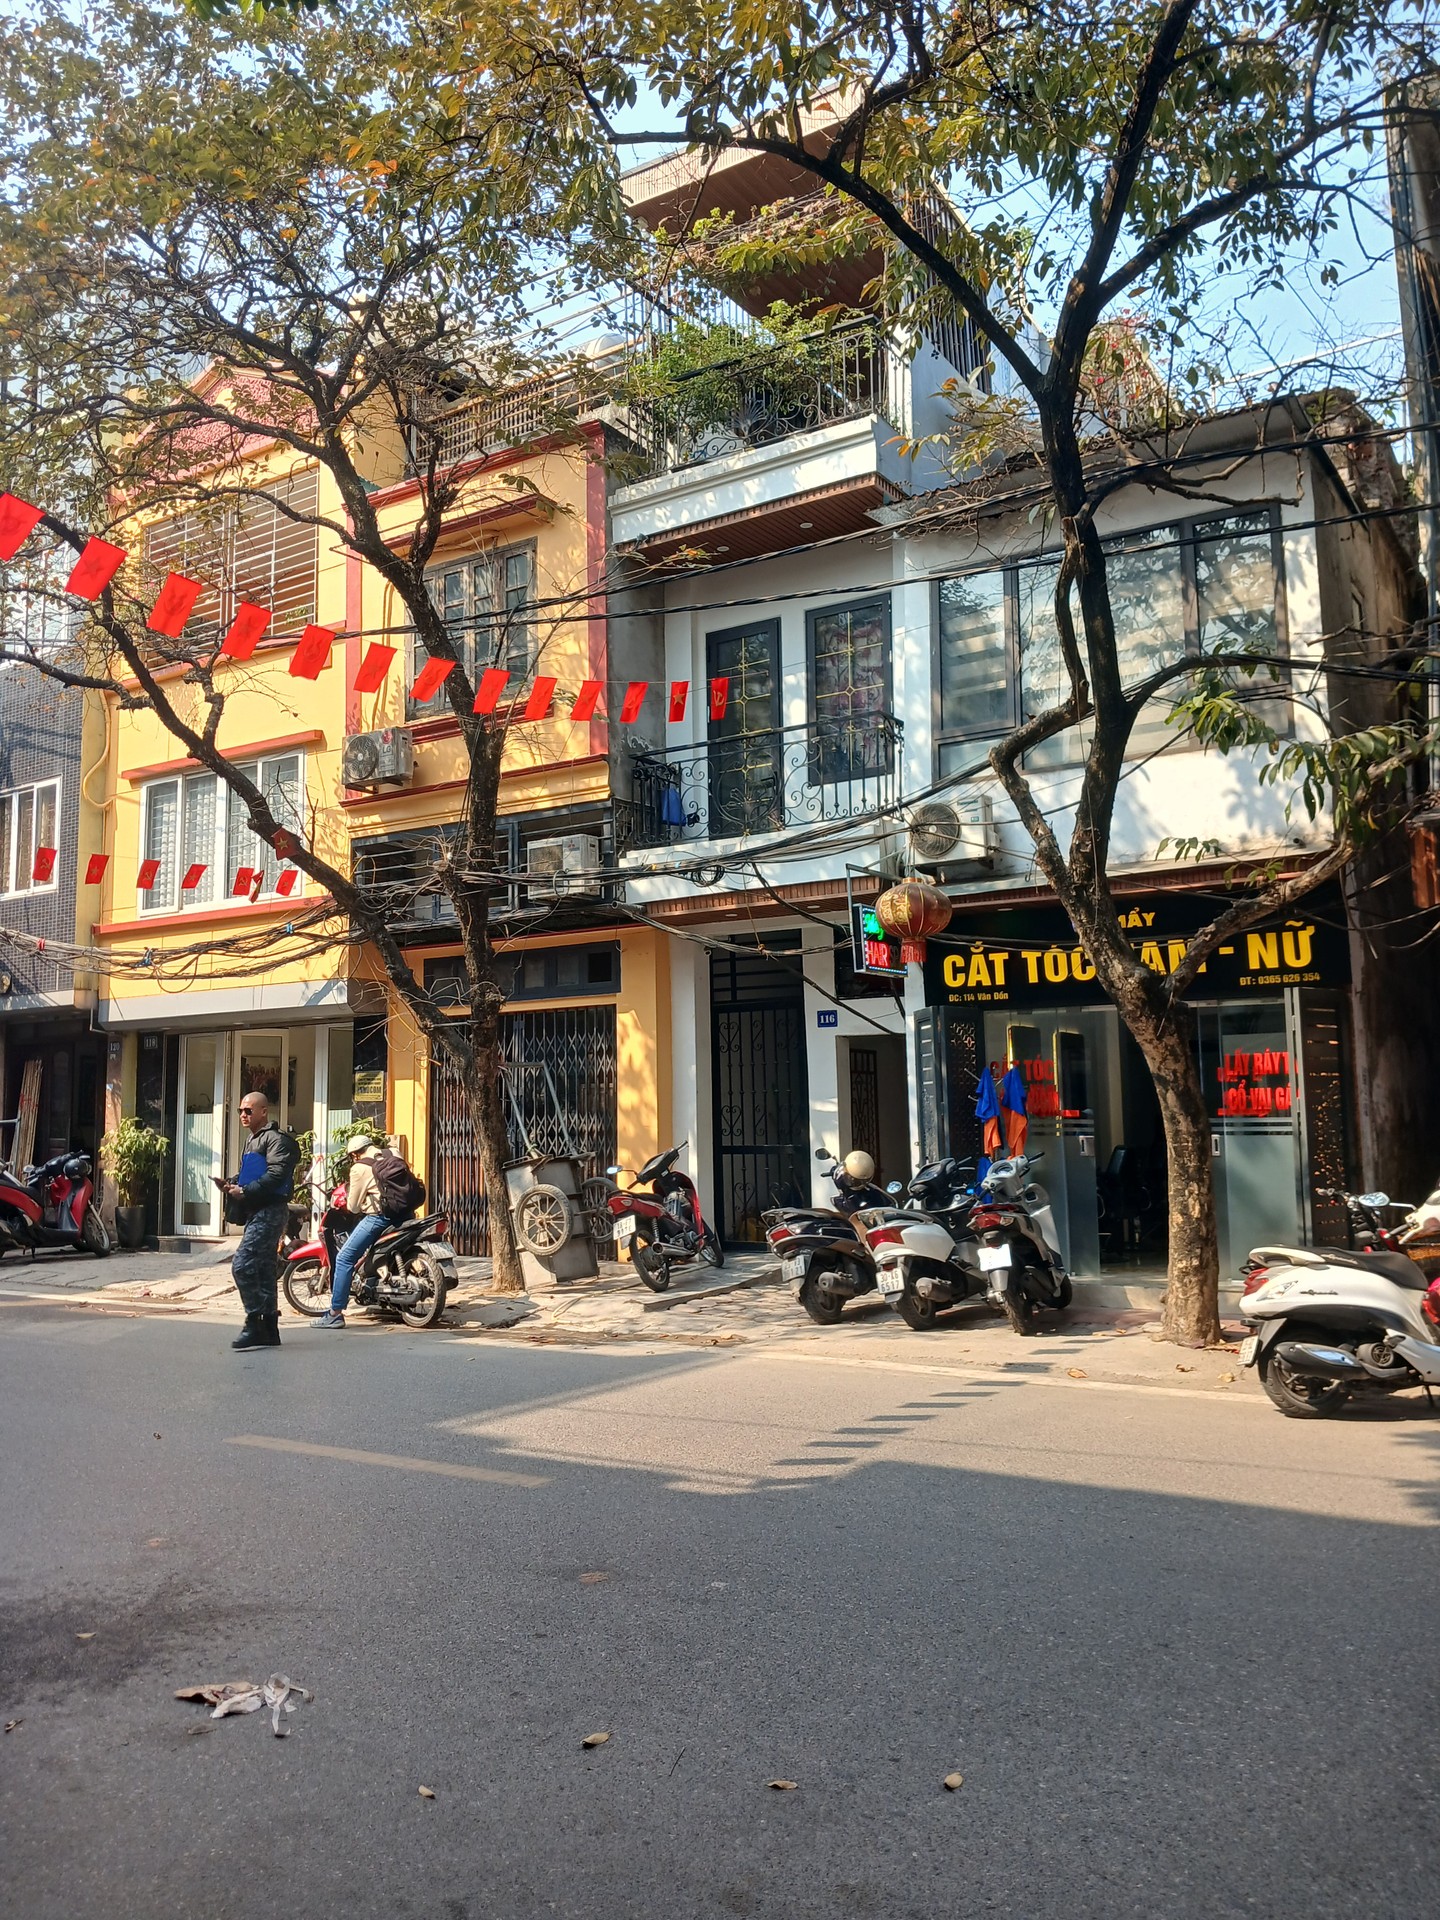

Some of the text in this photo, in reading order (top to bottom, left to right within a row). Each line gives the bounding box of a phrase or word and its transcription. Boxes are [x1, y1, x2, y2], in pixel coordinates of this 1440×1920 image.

[943, 941, 1009, 988] CẮT
[1021, 944, 1097, 983] TÓC
[1130, 938, 1207, 975] AM
[1247, 920, 1315, 970] NỮ
[1258, 974, 1281, 985] 0365
[1282, 973, 1300, 983] 626
[1302, 971, 1321, 981] 354
[963, 993, 975, 1001] 114
[820, 1014, 835, 1024] 116
[880, 1279, 900, 1293] 6517
